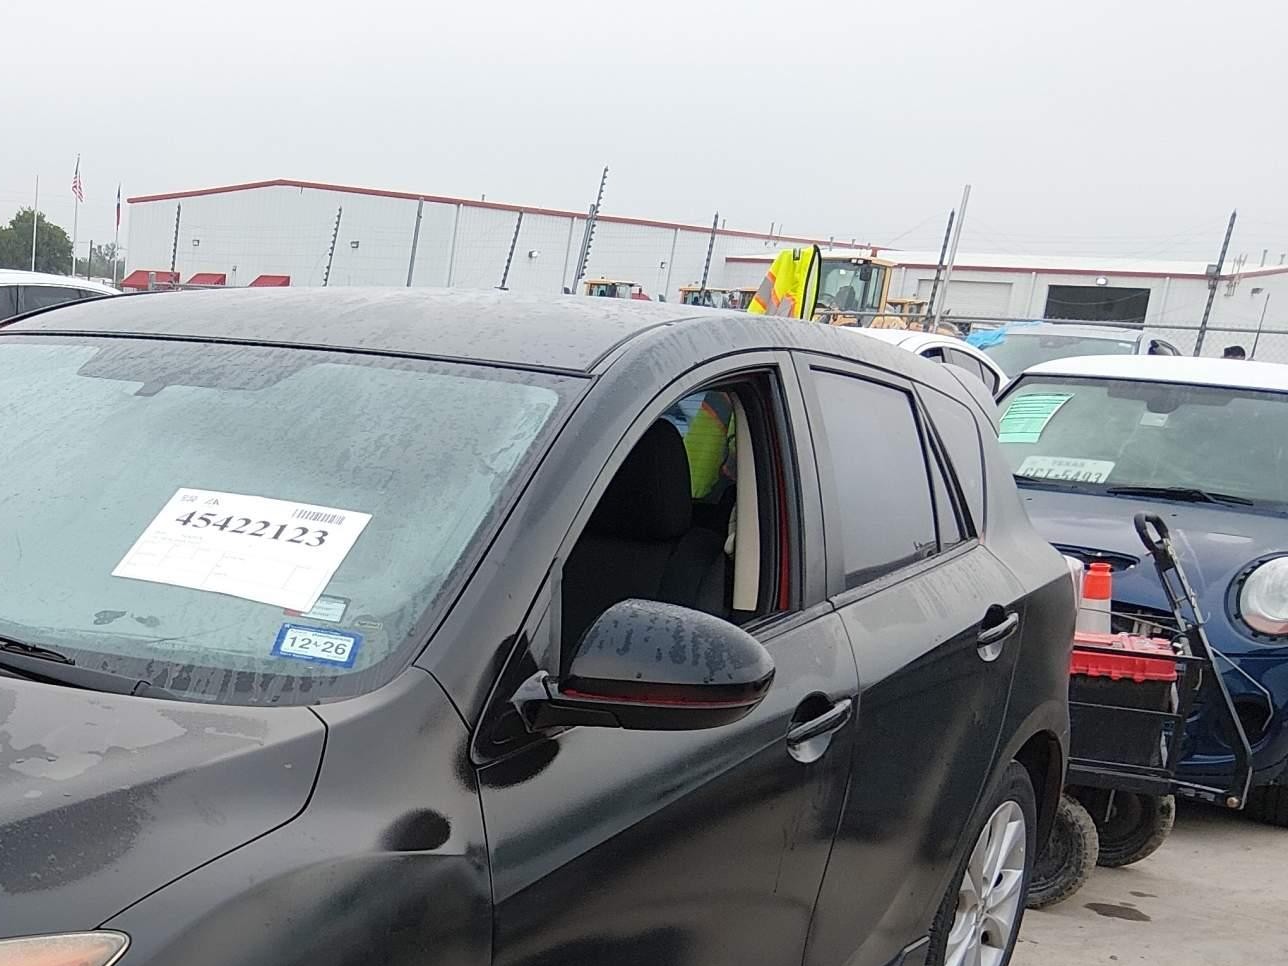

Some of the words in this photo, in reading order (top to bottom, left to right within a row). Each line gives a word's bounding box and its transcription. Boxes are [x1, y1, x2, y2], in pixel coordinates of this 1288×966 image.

[175, 510, 330, 548] 45422123
[288, 636, 313, 650] 12
[321, 641, 348, 656] 26
